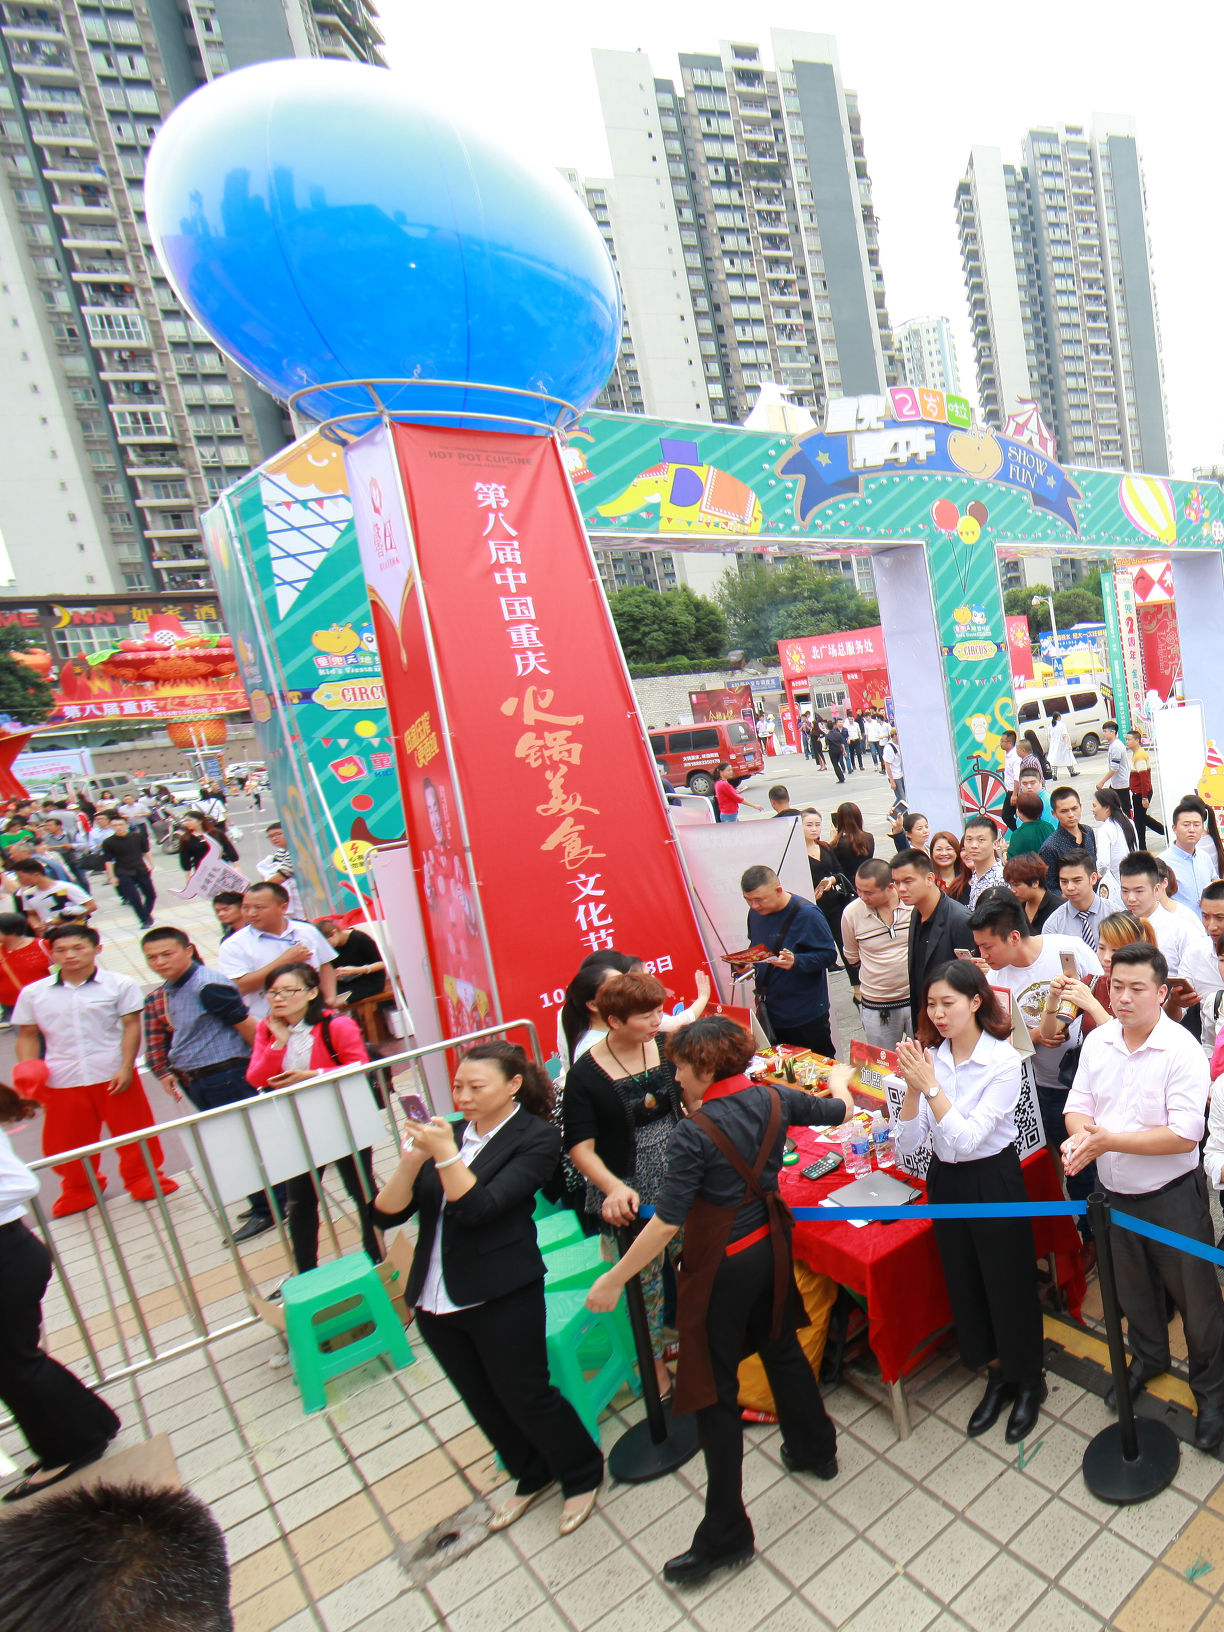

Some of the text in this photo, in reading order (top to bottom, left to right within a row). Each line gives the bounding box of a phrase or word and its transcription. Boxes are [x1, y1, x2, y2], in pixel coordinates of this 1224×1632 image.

[429, 451, 453, 460] HOT
[458, 453, 482, 462] POT
[486, 455, 533, 466] CUISINE
[1008, 445, 1048, 476] SHOW
[1009, 466, 1038, 488] FUN
[810, 638, 875, 660] 北广场总服务处
[540, 988, 566, 1008] 10
